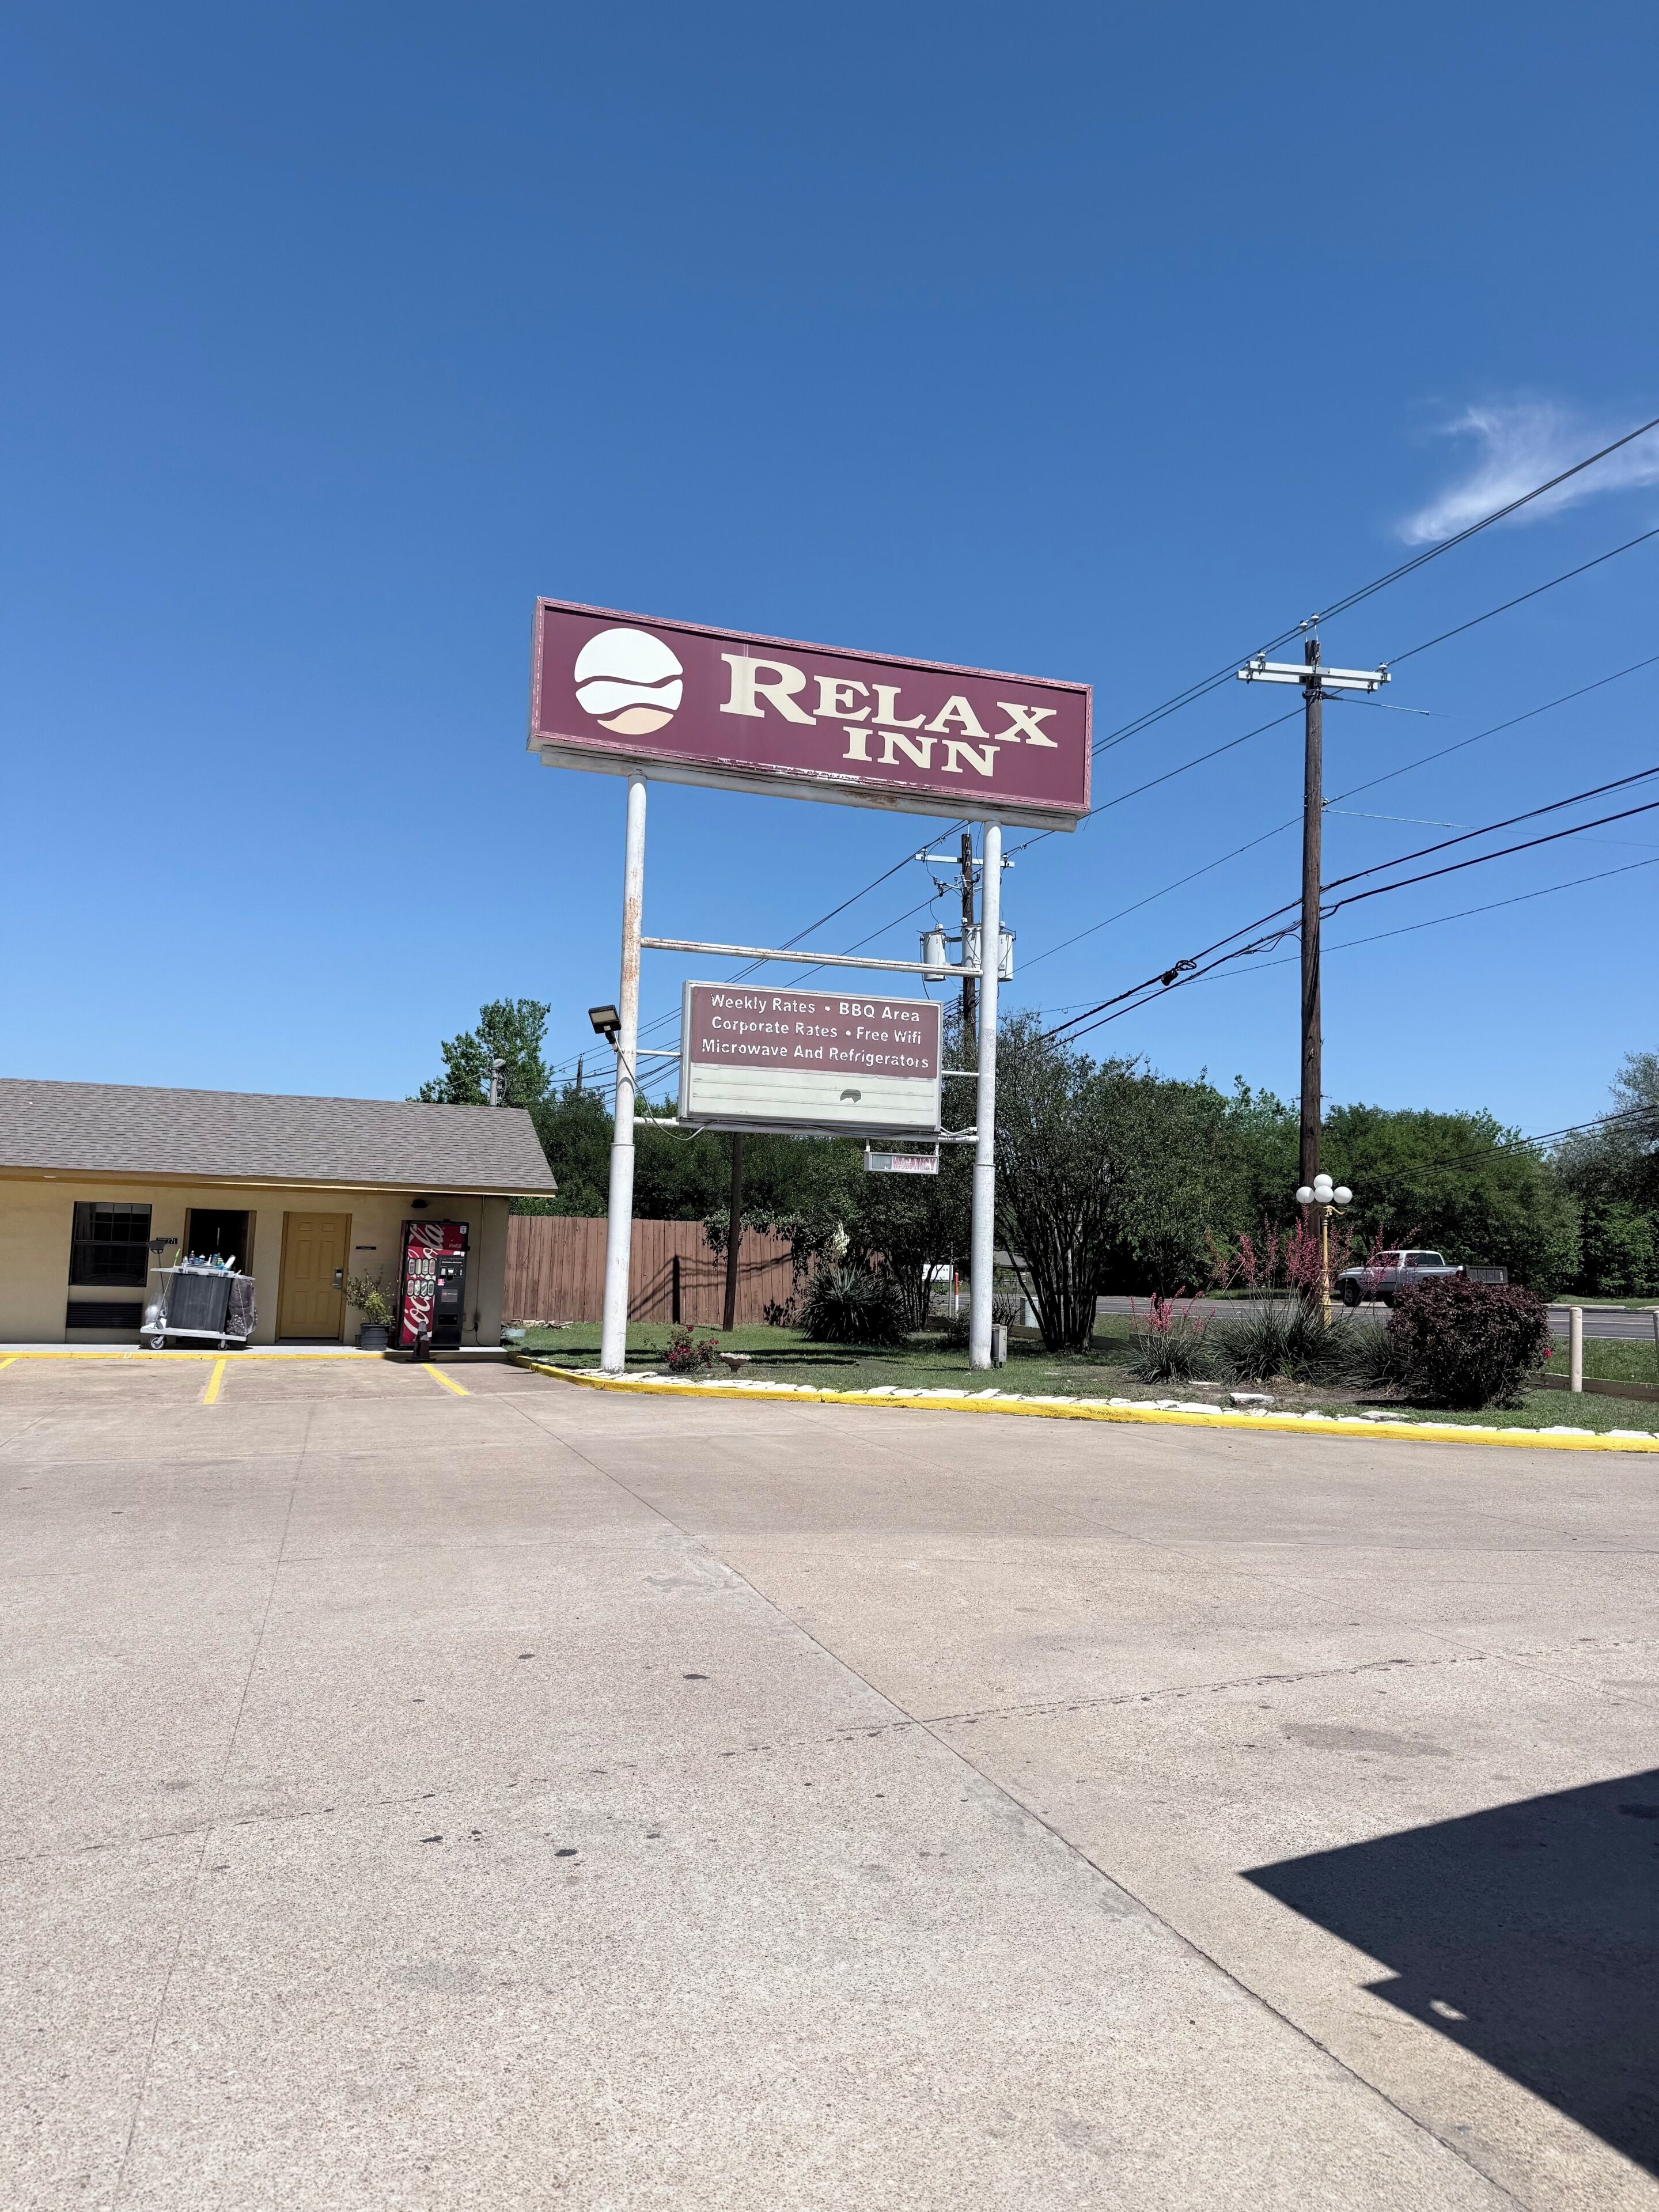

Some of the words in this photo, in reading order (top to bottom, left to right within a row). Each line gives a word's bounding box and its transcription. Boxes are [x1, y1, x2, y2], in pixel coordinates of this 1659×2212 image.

[719, 653, 1058, 748] RELAX
[843, 726, 1000, 777] INN
[711, 994, 767, 1014] Weekly
[772, 997, 816, 1013] Rates
[839, 1002, 875, 1019] BBQ
[881, 1006, 920, 1022] Area
[711, 1016, 789, 1035] Corporate
[796, 1022, 838, 1037] Rates
[857, 1026, 889, 1041] Free
[894, 1029, 921, 1045] Wifi
[702, 1039, 788, 1057] Microwave
[794, 1044, 823, 1059] And
[830, 1047, 929, 1069] Refrigerators
[892, 1156, 936, 1171] VACANCY
